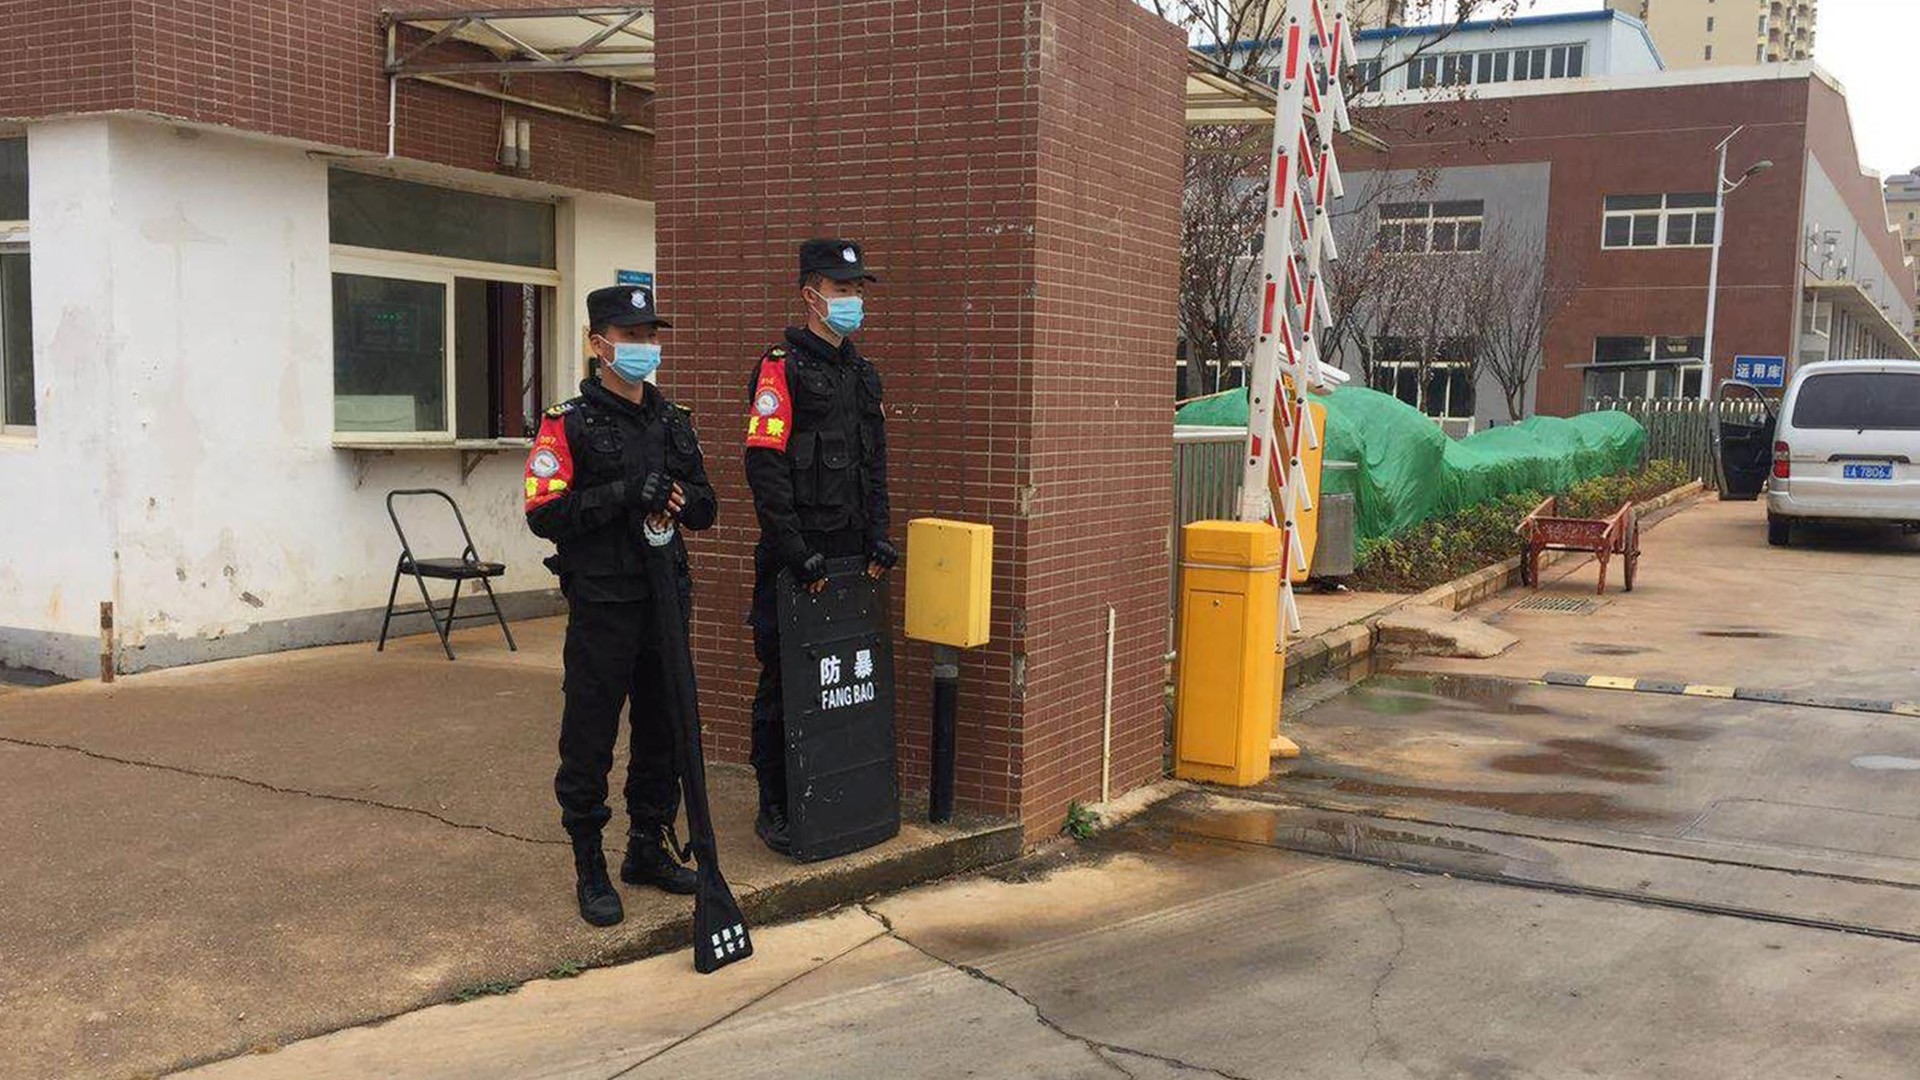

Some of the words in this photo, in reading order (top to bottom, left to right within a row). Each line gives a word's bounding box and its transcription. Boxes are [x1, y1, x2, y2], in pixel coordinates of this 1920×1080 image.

[1736, 363, 1782, 379] 运用库
[820, 649, 873, 686] 防暴
[821, 685, 852, 710] FANG
[853, 681, 875, 704] BAO
